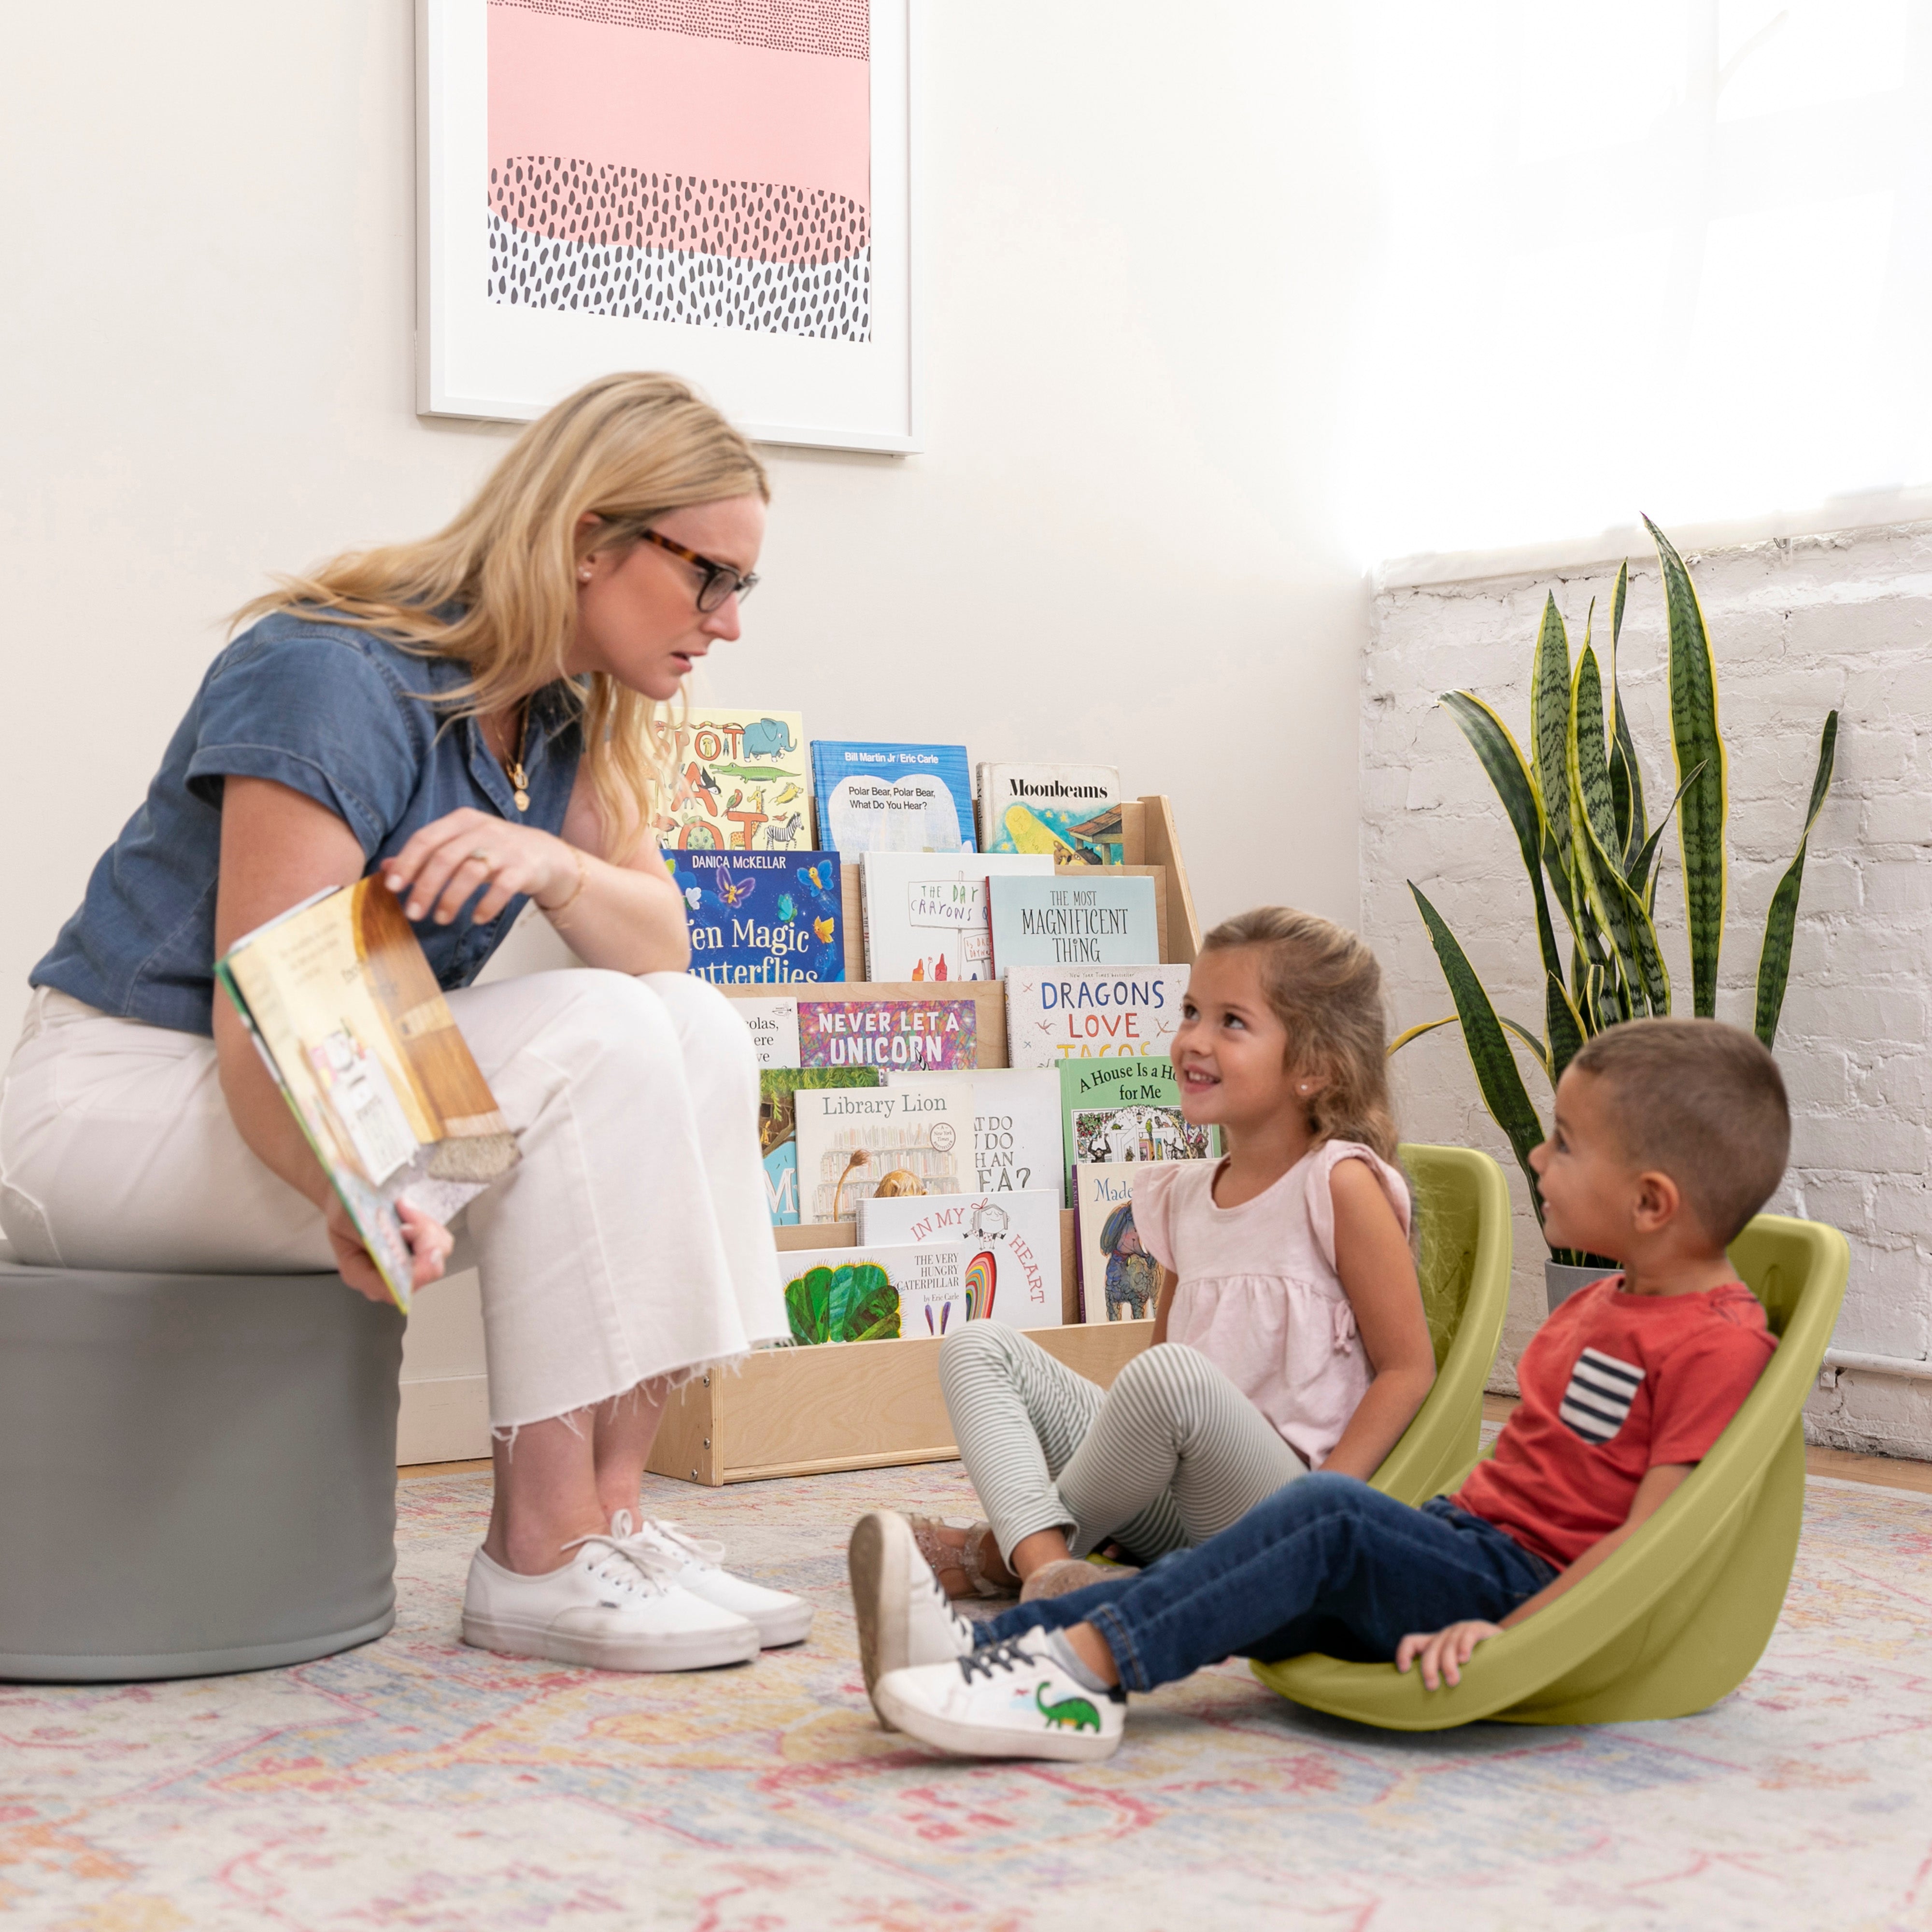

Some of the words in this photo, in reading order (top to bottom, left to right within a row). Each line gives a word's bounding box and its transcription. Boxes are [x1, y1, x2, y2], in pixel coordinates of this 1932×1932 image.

[845, 752, 858, 762] Bill
[859, 753, 886, 763] Martin
[887, 753, 895, 763] Jr
[900, 753, 916, 764] Eric
[917, 754, 939, 764] Carle
[849, 786, 869, 796] Polar
[872, 787, 892, 797] Bear,
[893, 787, 913, 797] Polar
[916, 788, 936, 798] Bear,
[1009, 779, 1108, 799] Moonbeams
[849, 800, 871, 809] What
[873, 800, 885, 809] Do
[886, 801, 902, 810] You
[904, 801, 927, 810] Hear?
[678, 811, 768, 850] OT
[692, 855, 730, 868] DANICA
[733, 856, 786, 869] McKELLAR
[921, 885, 942, 898] THE
[952, 884, 979, 904] DAY
[1050, 891, 1069, 906] THE
[1073, 891, 1097, 906] MOST
[911, 899, 972, 922] CRAYONS
[1021, 909, 1128, 936] MAGNIFICENT
[686, 919, 724, 950] en
[732, 919, 809, 955] Magic
[1041, 980, 1164, 1009] DRAGONS
[745, 1017, 779, 1032] olas,
[819, 1012, 891, 1033] NEVER
[900, 1011, 939, 1032] LET
[946, 1012, 960, 1032] A
[1069, 1012, 1140, 1038] LOVE
[754, 1036, 774, 1046] ere
[830, 1036, 942, 1064] UNICORN
[1080, 1078, 1092, 1094] A
[1090, 1066, 1134, 1087] House
[1136, 1062, 1148, 1077] Is
[1151, 1067, 1158, 1078] a
[1119, 1084, 1138, 1100] for
[1140, 1085, 1162, 1099] Me
[822, 1096, 895, 1118] Library
[902, 1094, 947, 1112] Lion
[988, 1116, 1013, 1131] DO
[984, 1132, 1013, 1150] DO
[990, 1151, 1014, 1167] AN
[977, 1167, 1031, 1193] EA?
[1094, 1178, 1134, 1202] Made
[910, 1217, 933, 1241] IN
[935, 1208, 966, 1228] MY
[914, 1254, 933, 1266] THE
[936, 1252, 959, 1264] VERY
[1009, 1234, 1044, 1304] HEART
[921, 1265, 959, 1278] HUNGRY
[897, 1277, 959, 1291] CATERPILLAR
[923, 1294, 931, 1303] by
[931, 1293, 944, 1302] Eric
[944, 1293, 959, 1301] Carle
